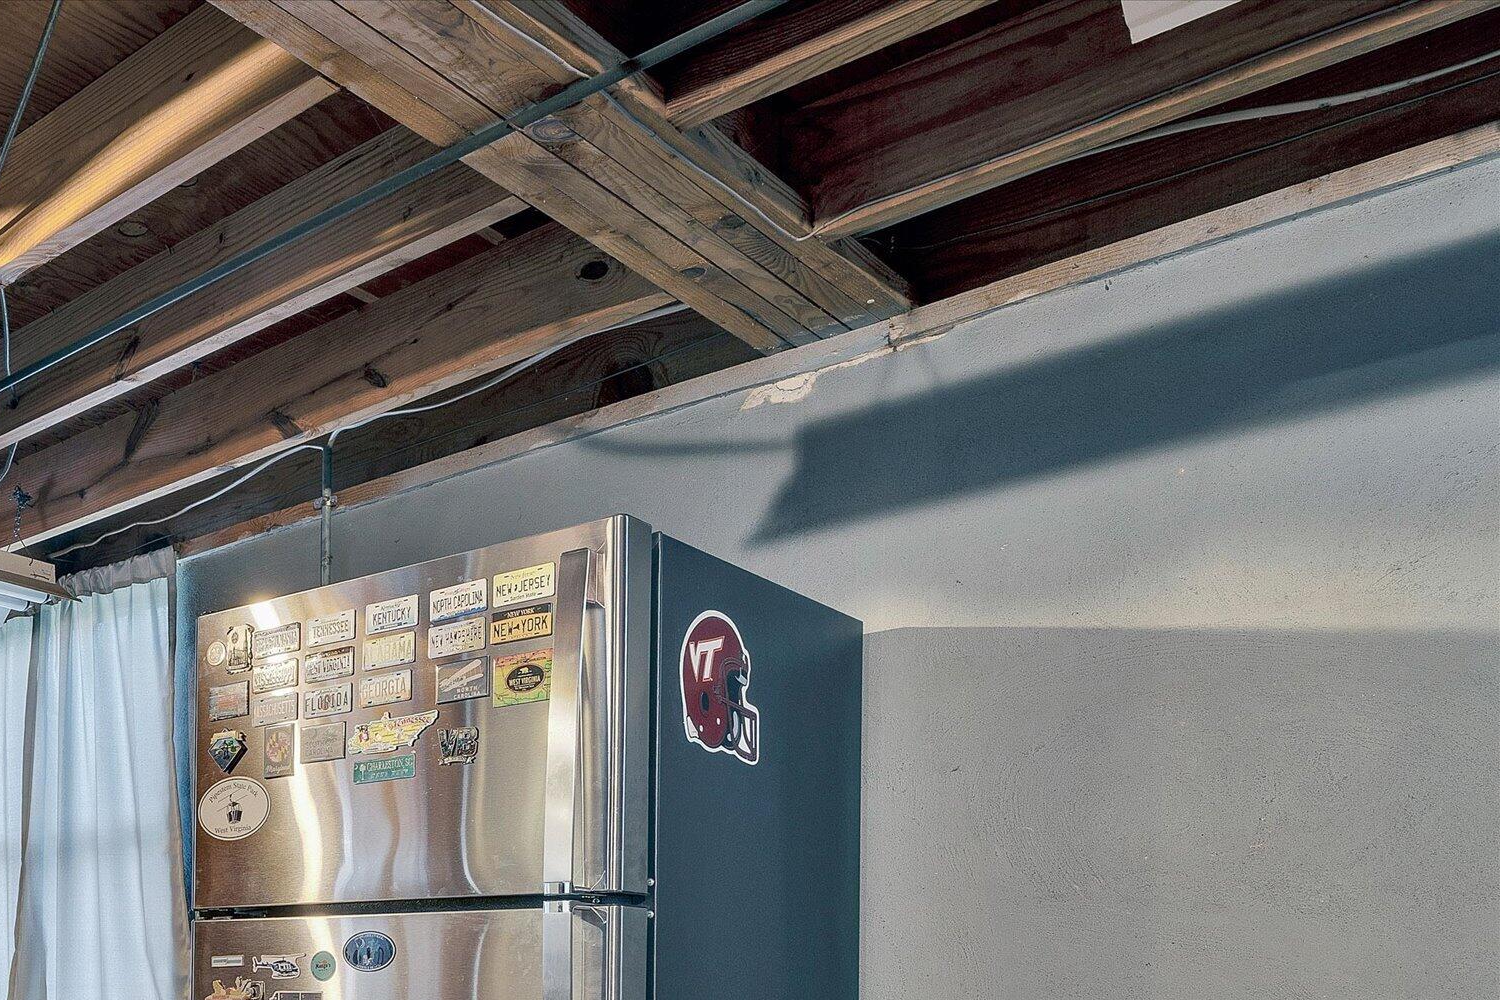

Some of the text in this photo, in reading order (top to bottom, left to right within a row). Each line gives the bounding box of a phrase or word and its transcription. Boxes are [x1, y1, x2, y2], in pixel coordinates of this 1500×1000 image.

[496, 574, 551, 597] NEW JERSEY
[372, 606, 412, 626] KENTUCKY
[493, 615, 548, 639] NEW YORK
[688, 636, 725, 682] VT
[363, 677, 406, 698] GEORGIA
[305, 691, 348, 712] FLORIDA
[208, 783, 232, 804] Pipestem
[215, 825, 252, 834] West Virginia
